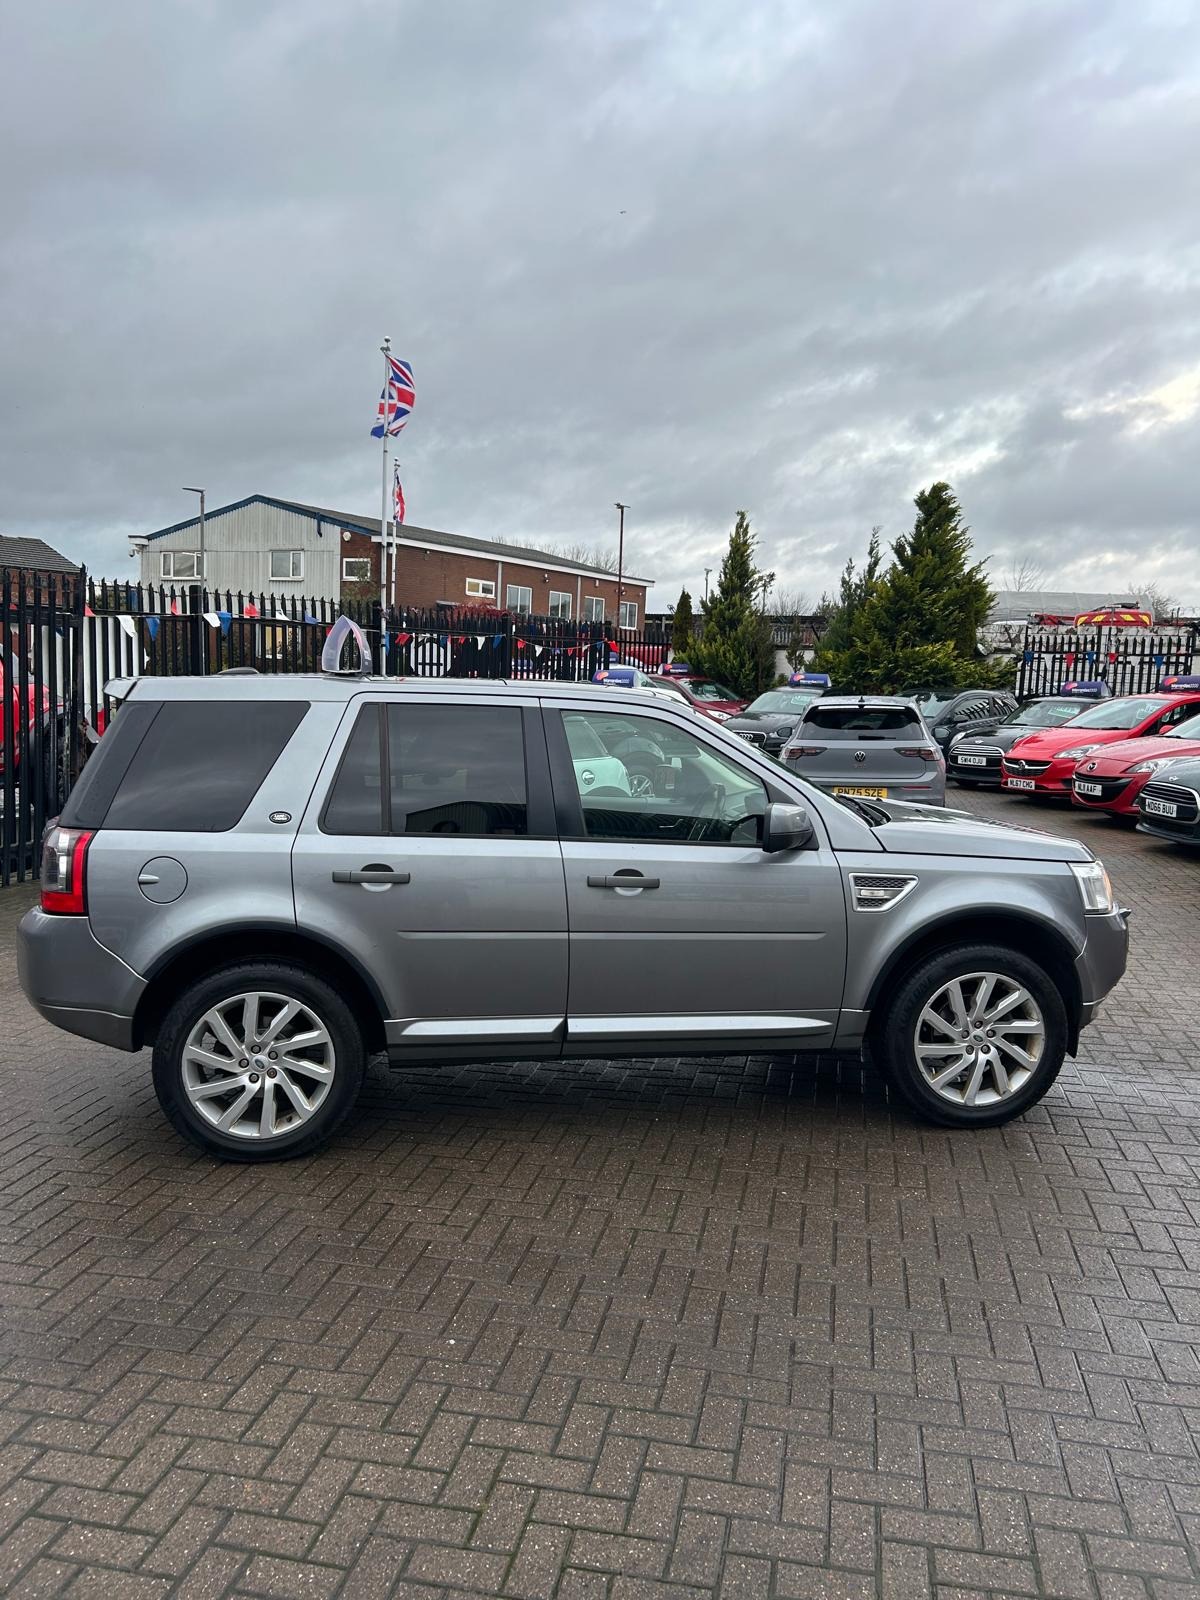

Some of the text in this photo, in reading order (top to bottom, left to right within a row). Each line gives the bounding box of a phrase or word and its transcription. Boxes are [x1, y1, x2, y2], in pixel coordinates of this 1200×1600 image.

[864, 788, 883, 797] SZE
[1146, 801, 1175, 815] ND66 BUU
